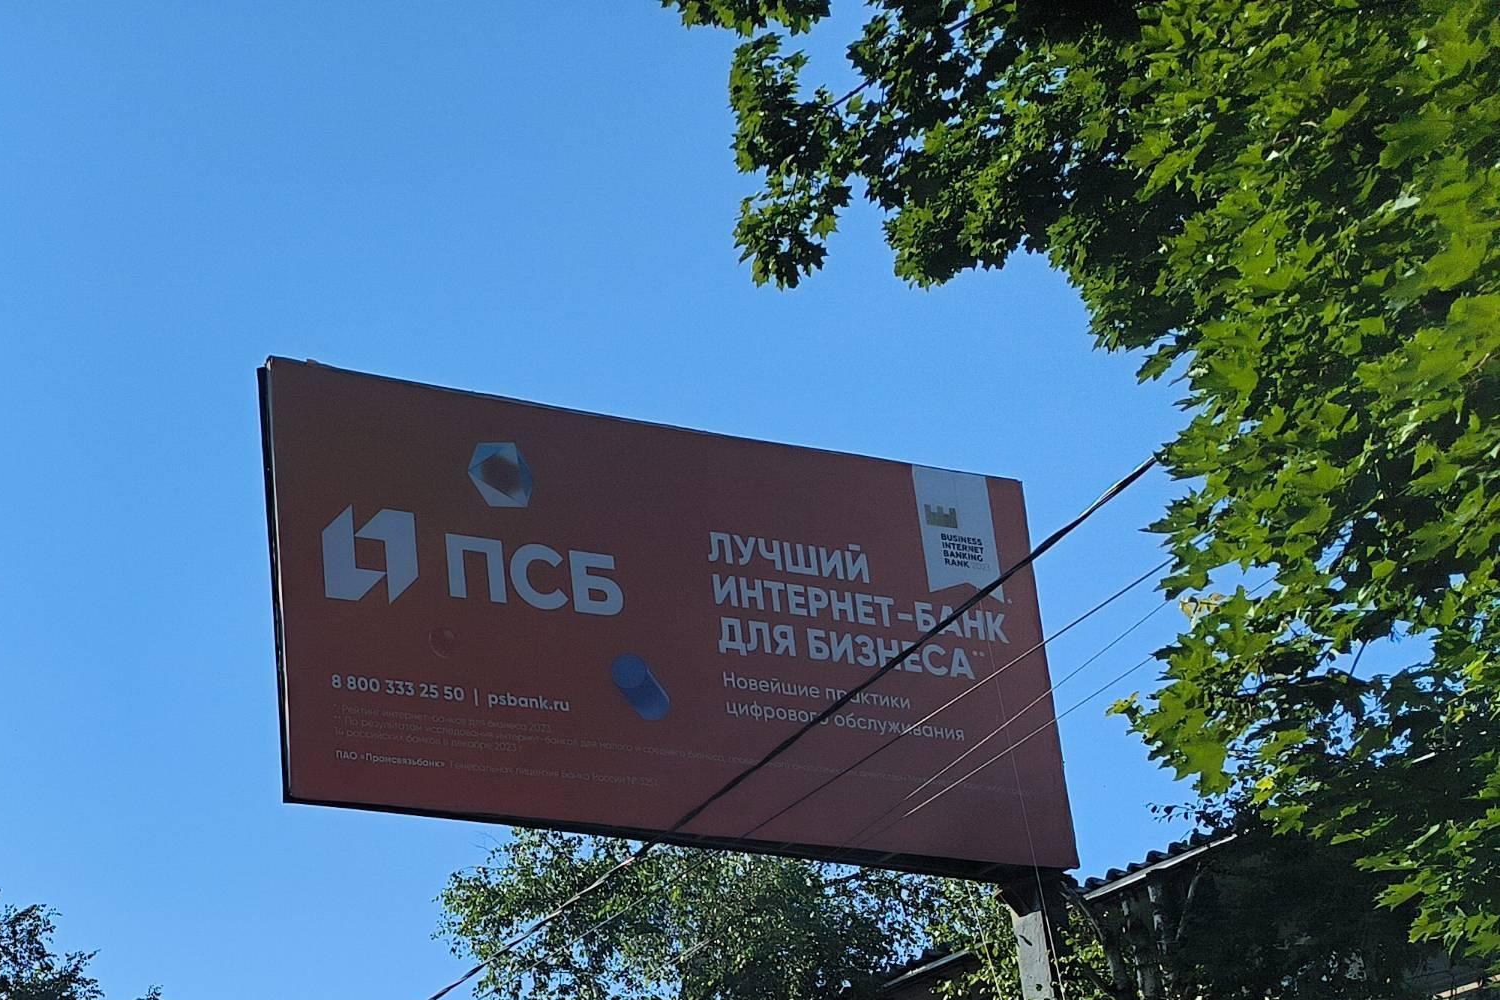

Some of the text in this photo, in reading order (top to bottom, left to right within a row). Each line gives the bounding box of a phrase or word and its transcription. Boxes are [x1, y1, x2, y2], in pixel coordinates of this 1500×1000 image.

[941, 533, 982, 545] BUSINESS
[942, 542, 984, 554] INTERNET
[708, 531, 870, 584] ЛУЧШИЙ
[943, 550, 983, 562] BANKING
[944, 558, 970, 568] RANK
[445, 533, 624, 616] ПСБ
[718, 616, 797, 657] ДЛЯ
[331, 674, 571, 712] 8 800 333 25 50 psbank.ru
[722, 671, 820, 699] Новейшие
[834, 712, 965, 741] обслуживания
[335, 750, 358, 760] ПАО
